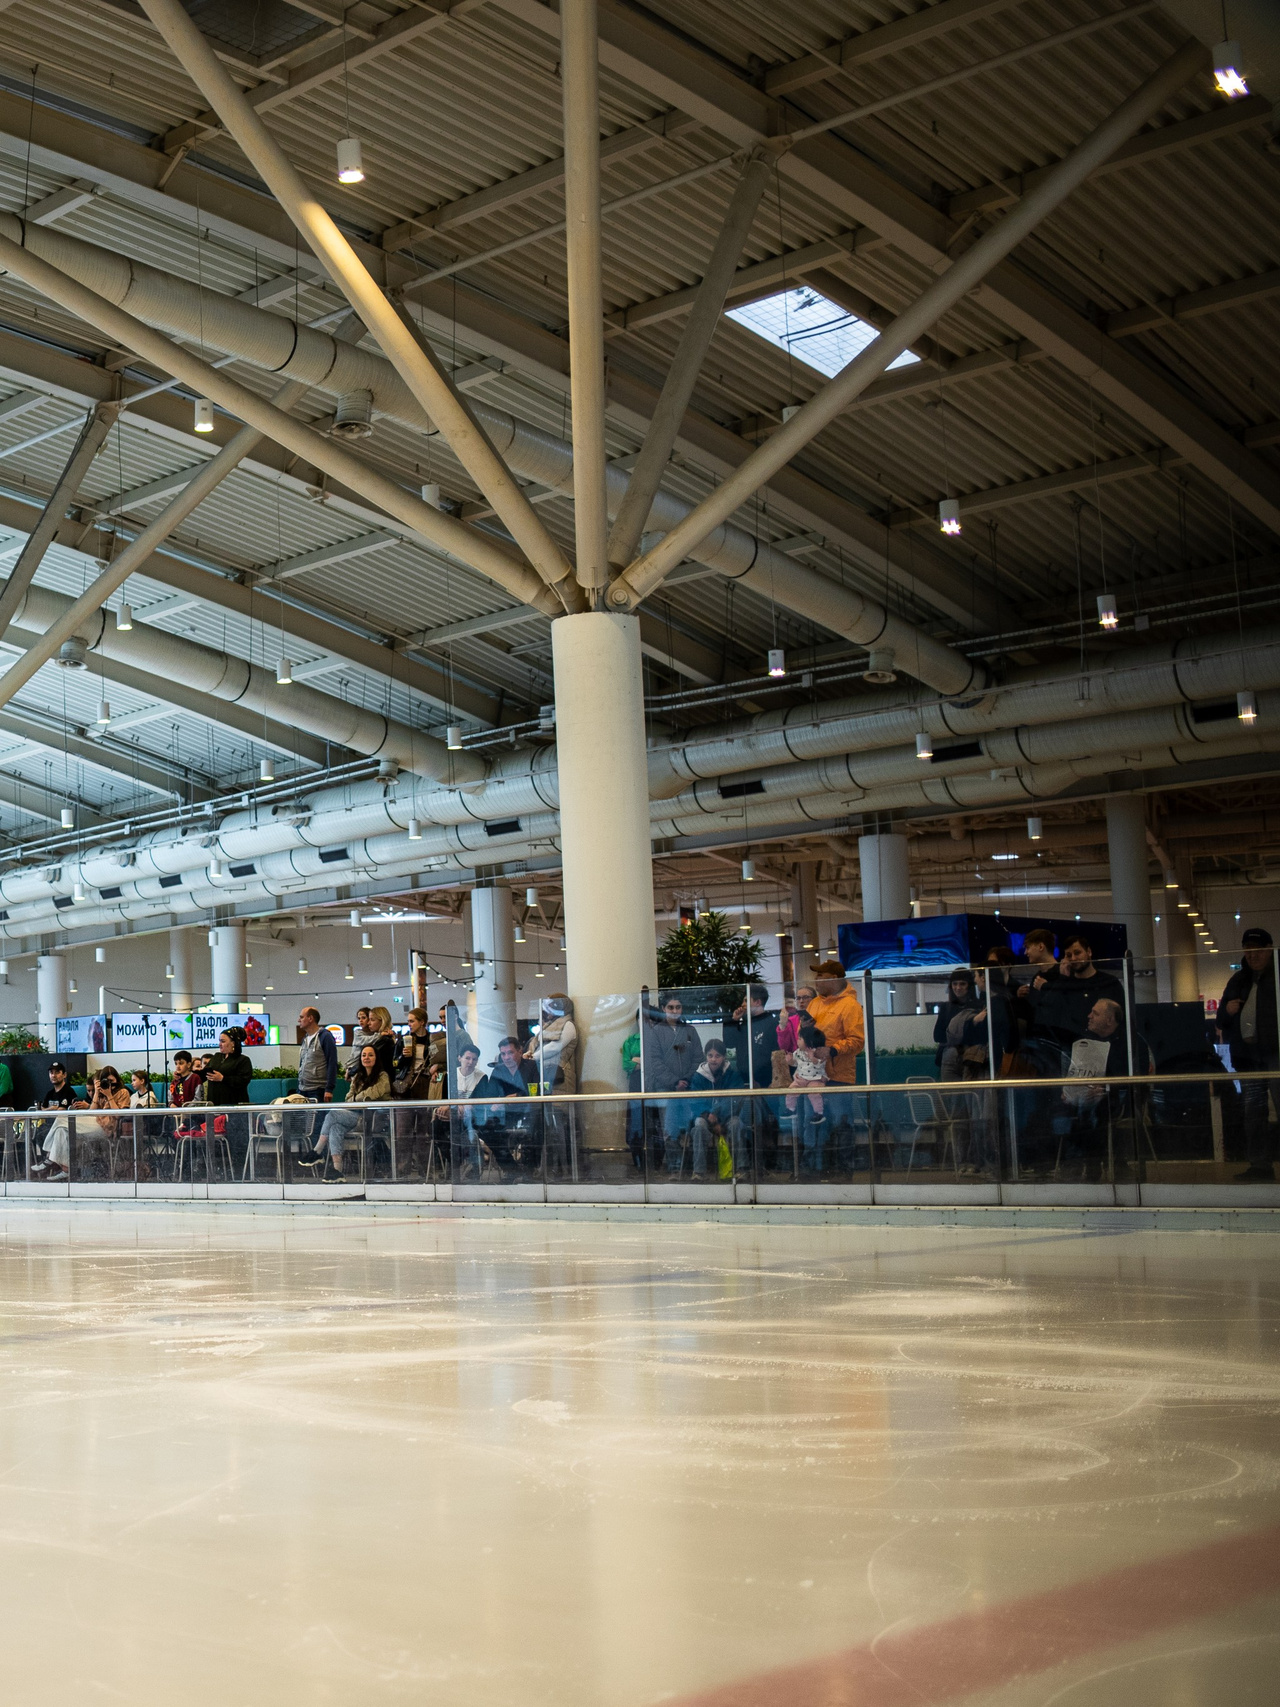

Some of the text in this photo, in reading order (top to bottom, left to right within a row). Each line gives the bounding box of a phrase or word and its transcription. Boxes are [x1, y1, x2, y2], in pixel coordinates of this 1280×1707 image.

[196, 1016, 228, 1028] ВАФЛЯ
[117, 1024, 157, 1036] МОХИО
[196, 1029, 216, 1040] ДНЯ
